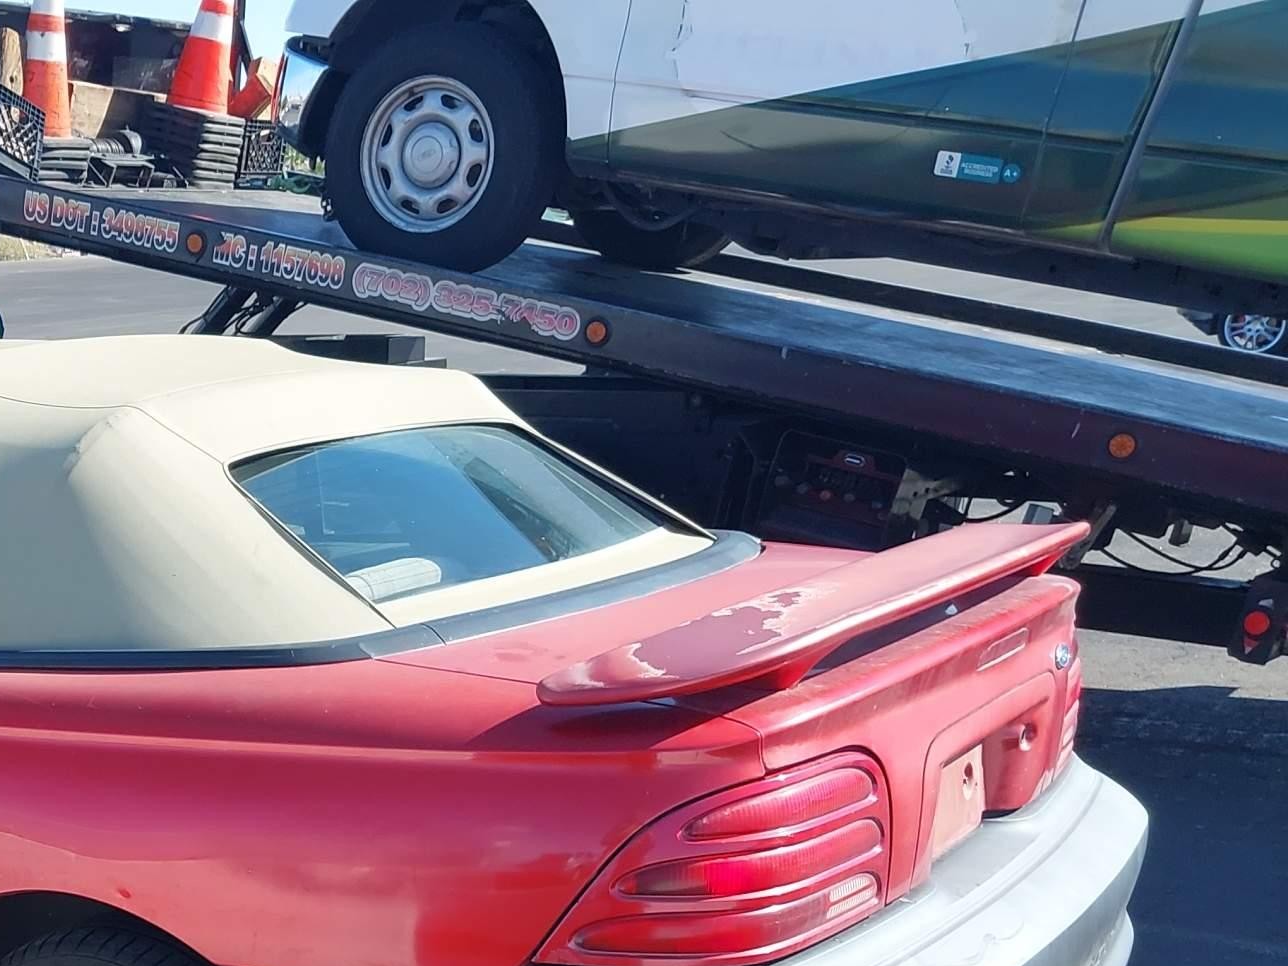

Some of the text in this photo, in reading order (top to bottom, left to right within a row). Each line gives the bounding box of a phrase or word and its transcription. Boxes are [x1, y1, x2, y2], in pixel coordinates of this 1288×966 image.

[23, 189, 49, 224] US
[50, 196, 91, 233] DOT
[101, 206, 181, 252] 3498755
[213, 231, 247, 268] MC
[260, 240, 346, 290] 1157698
[353, 263, 433, 311] (702)
